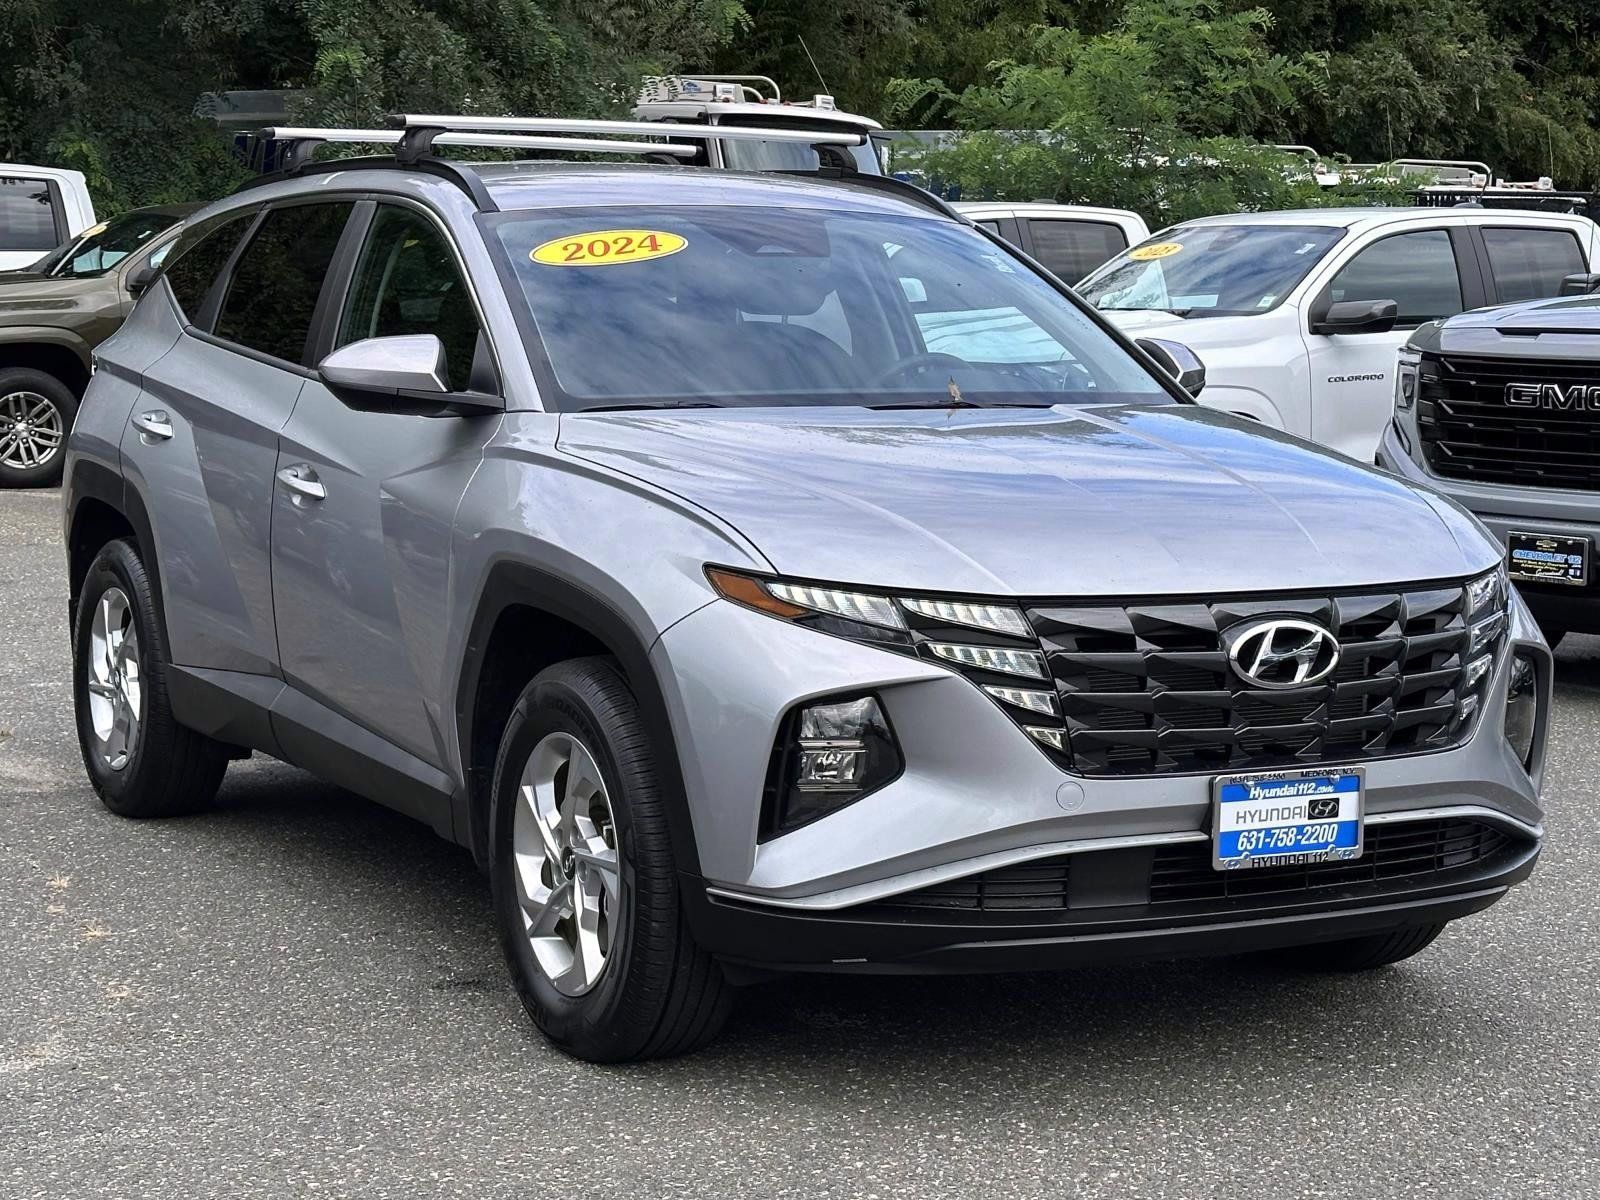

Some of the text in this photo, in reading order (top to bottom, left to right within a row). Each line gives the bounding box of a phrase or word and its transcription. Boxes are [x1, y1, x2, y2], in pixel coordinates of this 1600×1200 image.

[562, 234, 662, 262] 2024
[1328, 373, 1384, 383] COLORADO
[1513, 549, 1567, 563] CHEVROLET
[1236, 805, 1307, 824] HYUNDAI
[1237, 824, 1338, 850] 631-758-2200
[1251, 852, 1329, 868] HYUNDAI 112
